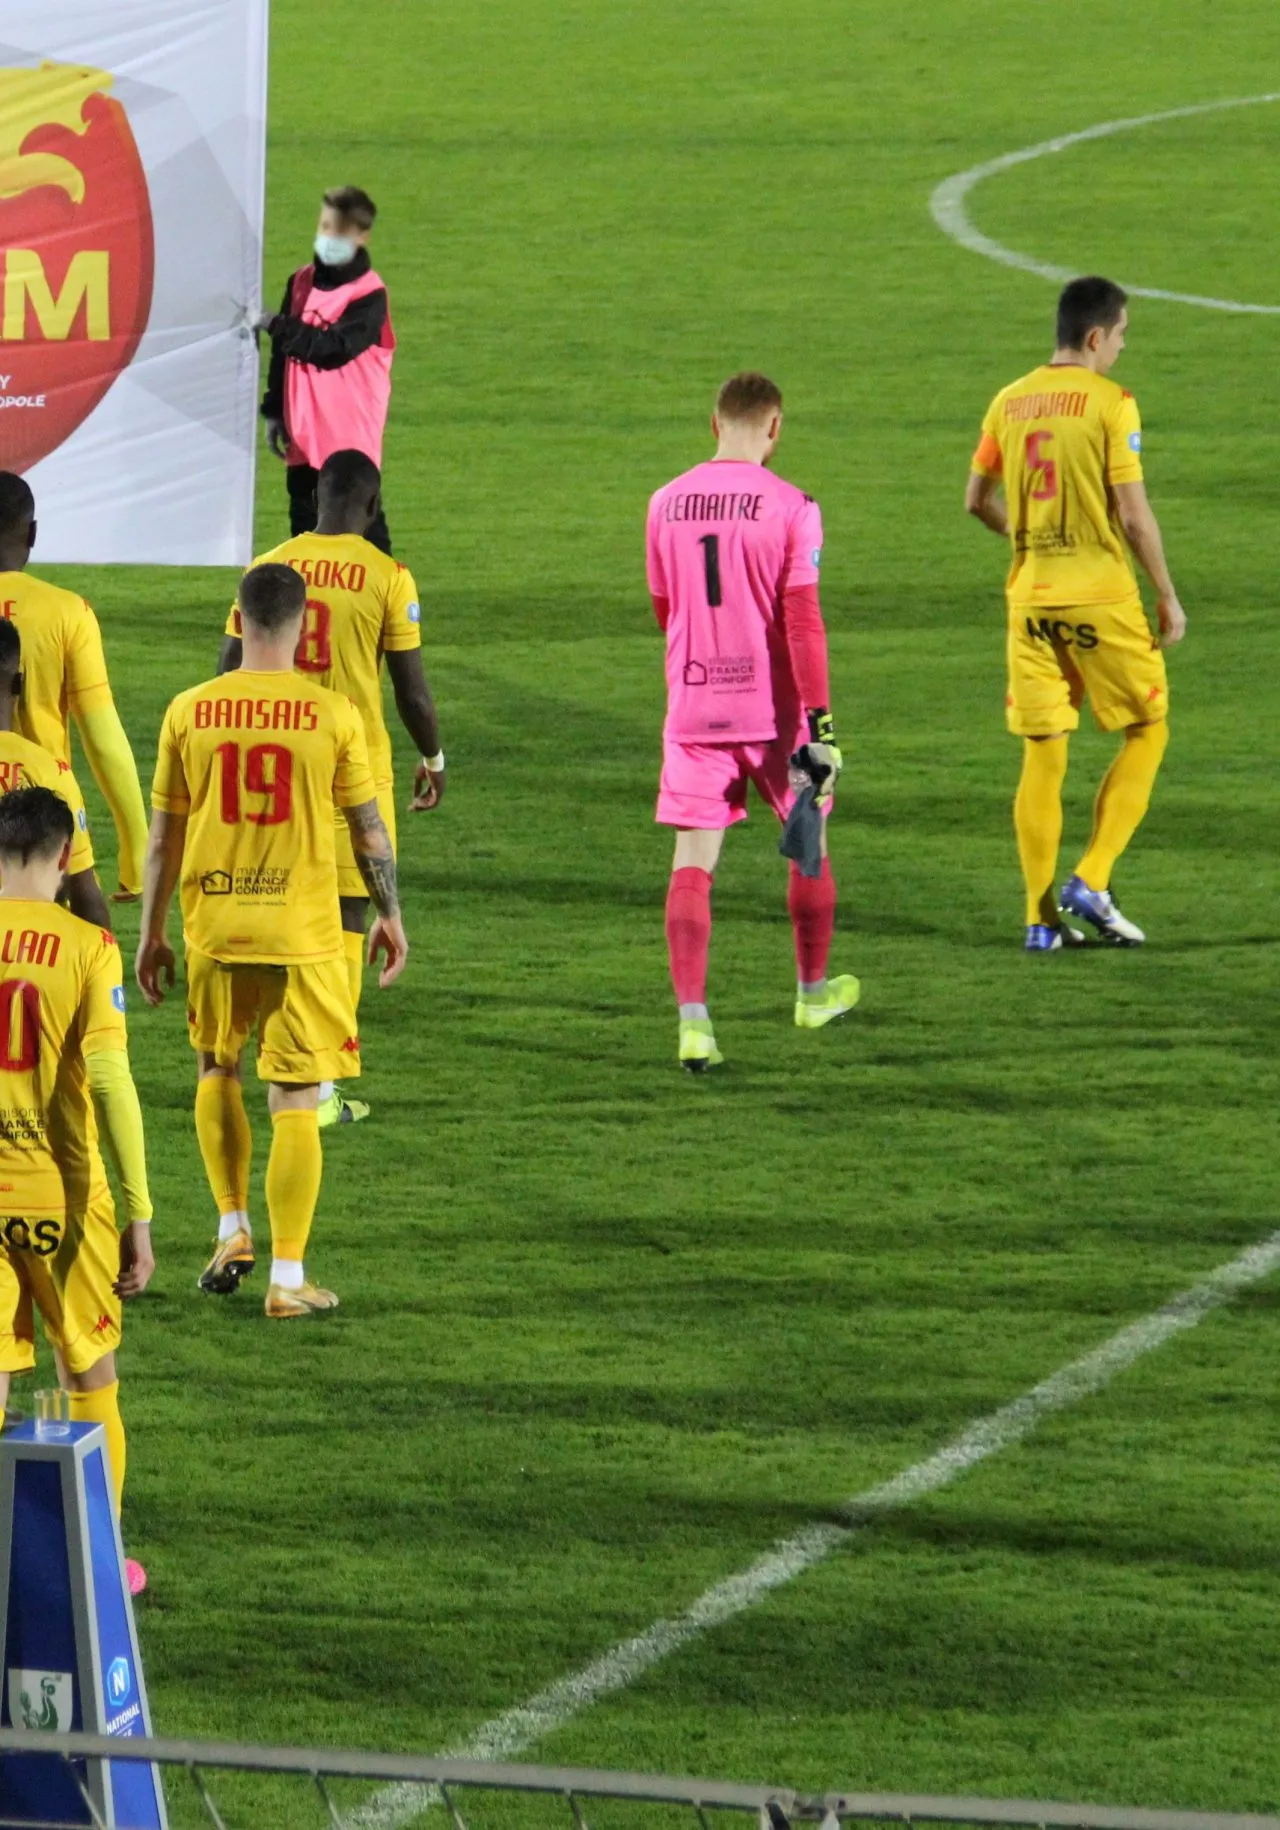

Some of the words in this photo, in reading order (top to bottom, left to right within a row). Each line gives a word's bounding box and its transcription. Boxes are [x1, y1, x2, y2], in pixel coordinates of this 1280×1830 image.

[1025, 430, 1057, 500] 5
[665, 492, 764, 522] LEMAITRE
[287, 559, 367, 593] SOKO
[697, 534, 722, 607] 1
[294, 599, 332, 673] 8
[1025, 617, 1099, 650] MCS
[195, 700, 319, 731] BANSAIS
[216, 742, 293, 826] 19
[235, 885, 287, 896] CONFORT
[106, 1703, 140, 1735] NATIONAL
